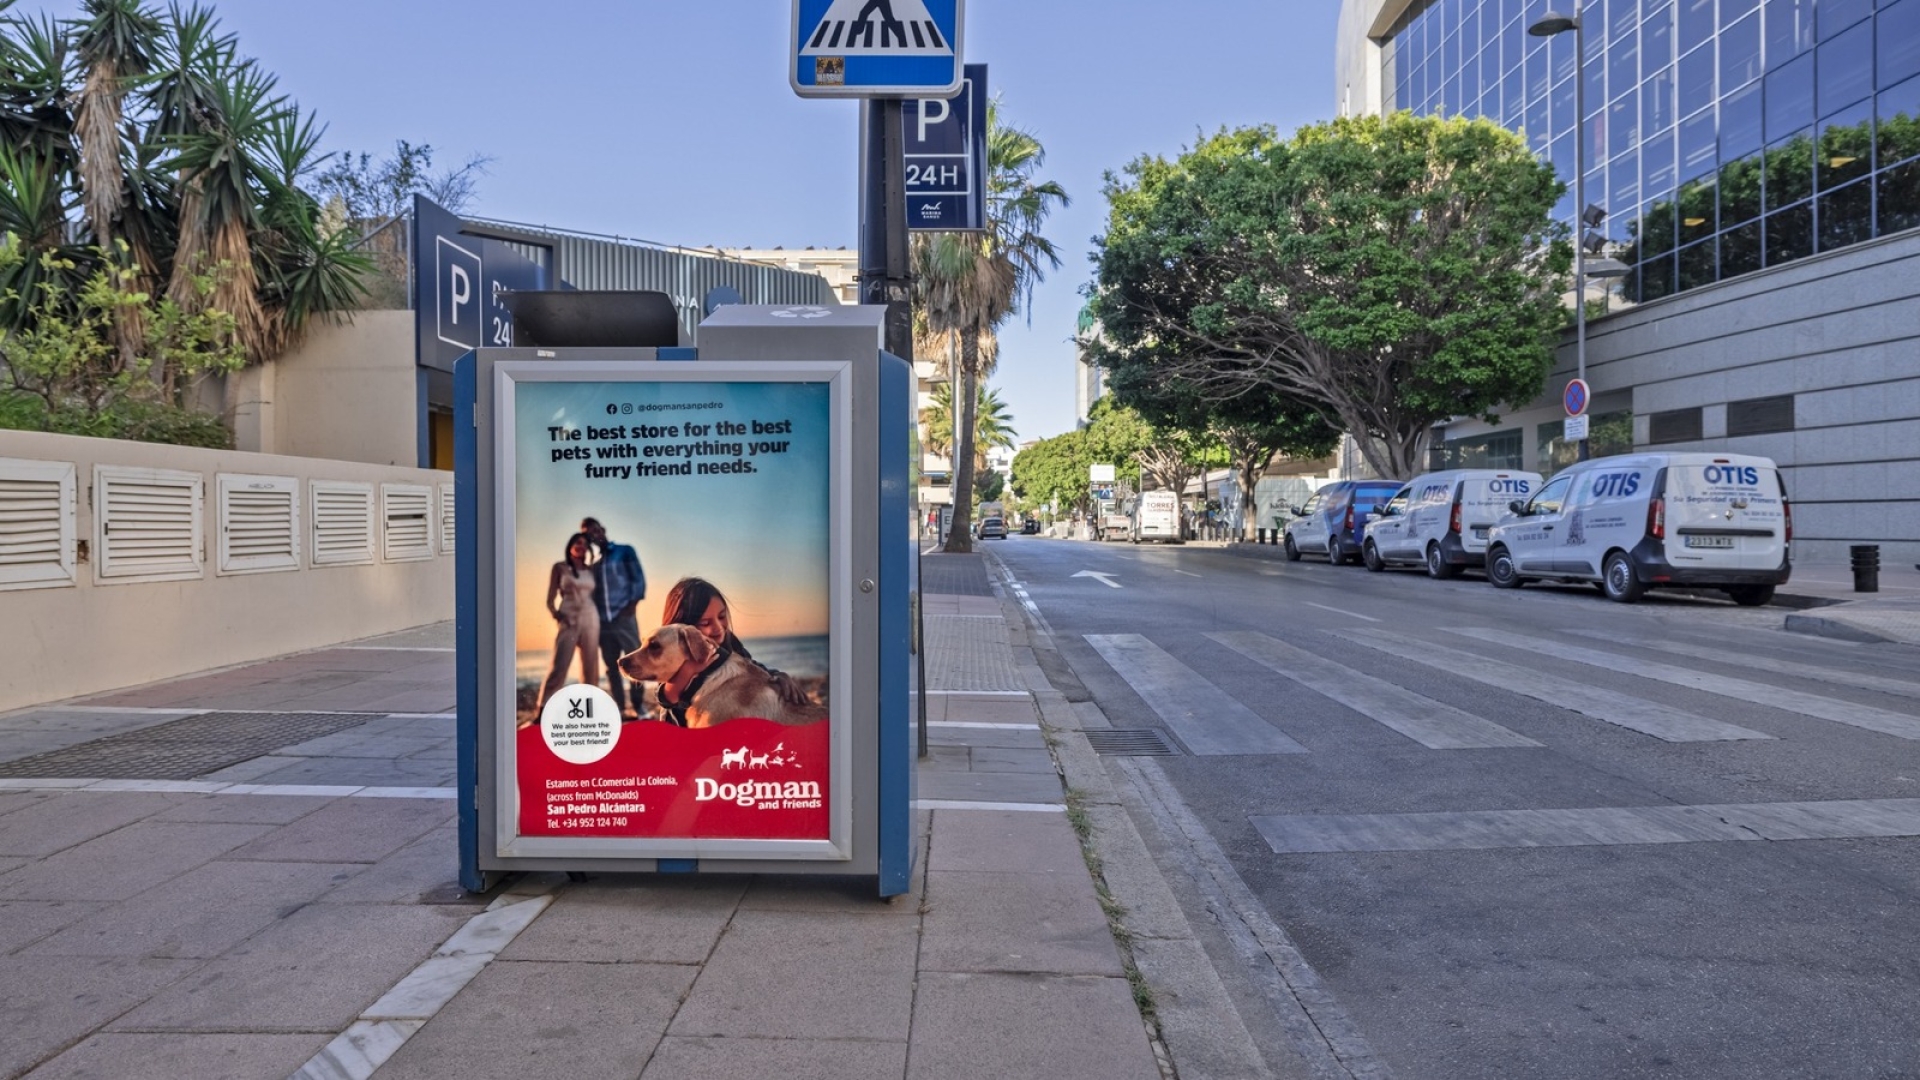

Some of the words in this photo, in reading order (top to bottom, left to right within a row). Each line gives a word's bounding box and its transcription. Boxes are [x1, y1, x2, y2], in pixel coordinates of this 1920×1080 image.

[917, 99, 950, 142] P
[905, 164, 958, 186] 24H
[451, 263, 470, 325] P
[638, 401, 724, 413] @dogmansanpedro
[548, 426, 582, 441] The
[587, 425, 627, 440] best
[631, 424, 679, 440] store
[684, 422, 711, 438] for
[715, 420, 747, 436] the
[751, 419, 792, 435] best
[551, 445, 591, 462] pets
[596, 443, 638, 459] with
[643, 439, 743, 458] everything
[748, 440, 790, 456] your
[585, 463, 632, 480] furry
[636, 460, 692, 477] friend
[697, 458, 758, 475] needs.
[1703, 465, 1759, 486] OTIS
[1422, 484, 1449, 502] OTIS
[1488, 479, 1530, 494] OTIS
[1592, 472, 1641, 498] OTIS
[1686, 496, 1727, 505] Seguridad
[546, 779, 579, 789] Estamos
[580, 778, 590, 788] en
[591, 777, 635, 787] C.Comercial
[636, 776, 647, 786] La
[647, 776, 678, 786] Colonia,
[546, 793, 574, 803] (across
[575, 791, 595, 801] from
[595, 790, 639, 801] McDonalds)
[695, 778, 822, 807] Dogman
[547, 804, 566, 816] San
[567, 803, 597, 815] Pedro
[599, 802, 645, 814] Alcántara
[758, 800, 780, 810] and
[782, 799, 822, 810] friends
[547, 819, 560, 829] Tel.
[562, 818, 578, 828] +34
[579, 818, 595, 828] 952
[596, 817, 611, 827] 124
[612, 816, 628, 827] 740
